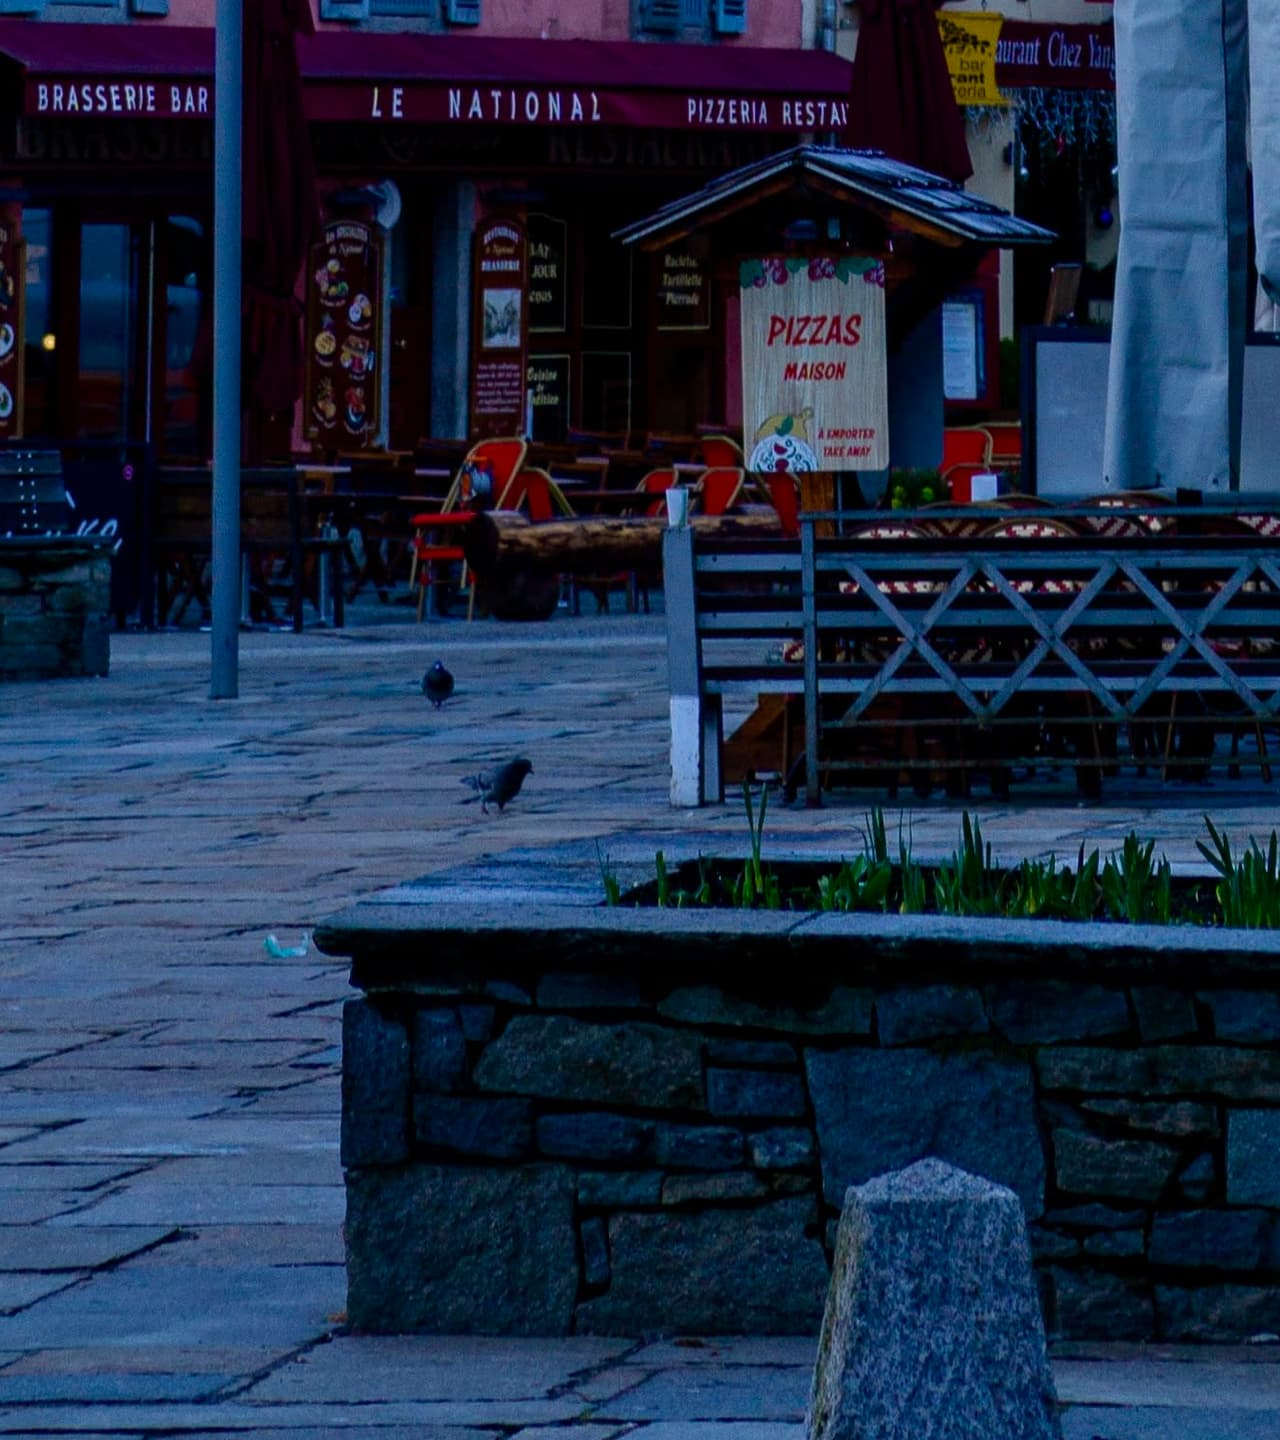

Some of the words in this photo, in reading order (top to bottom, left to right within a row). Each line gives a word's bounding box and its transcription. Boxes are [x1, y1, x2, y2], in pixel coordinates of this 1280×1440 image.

[1048, 31, 1082, 69] Chez
[37, 83, 157, 112] BRASSERIE
[170, 85, 209, 113] BAR
[371, 86, 404, 118] LE
[448, 88, 601, 122] NATIONAL
[687, 97, 768, 125] PIZZERIA
[782, 100, 849, 127] RESTA
[767, 313, 862, 347] PIZZAS
[784, 361, 846, 381] MAISON
[827, 429, 875, 439] EMPORTER
[823, 446, 844, 457] TAKE
[847, 446, 871, 457] AWAY
